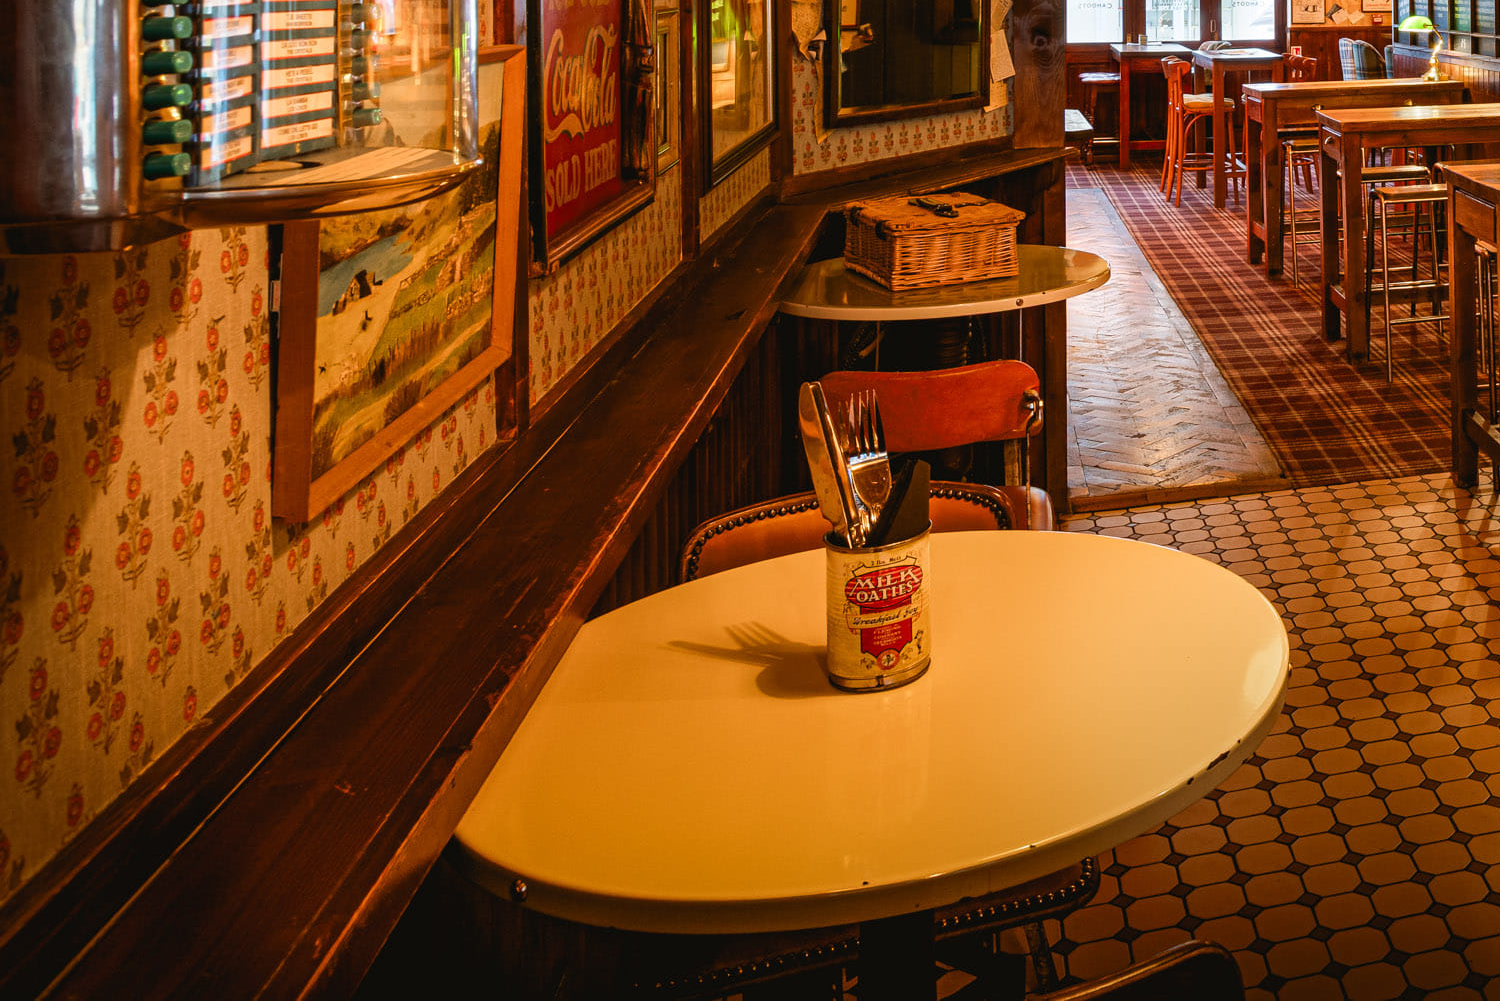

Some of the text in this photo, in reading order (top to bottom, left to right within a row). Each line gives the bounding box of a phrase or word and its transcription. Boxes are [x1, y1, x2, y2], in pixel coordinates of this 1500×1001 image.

[546, 138, 617, 213] SOLD HERE
[849, 568, 920, 597] MILK
[856, 580, 913, 603] OATIES
